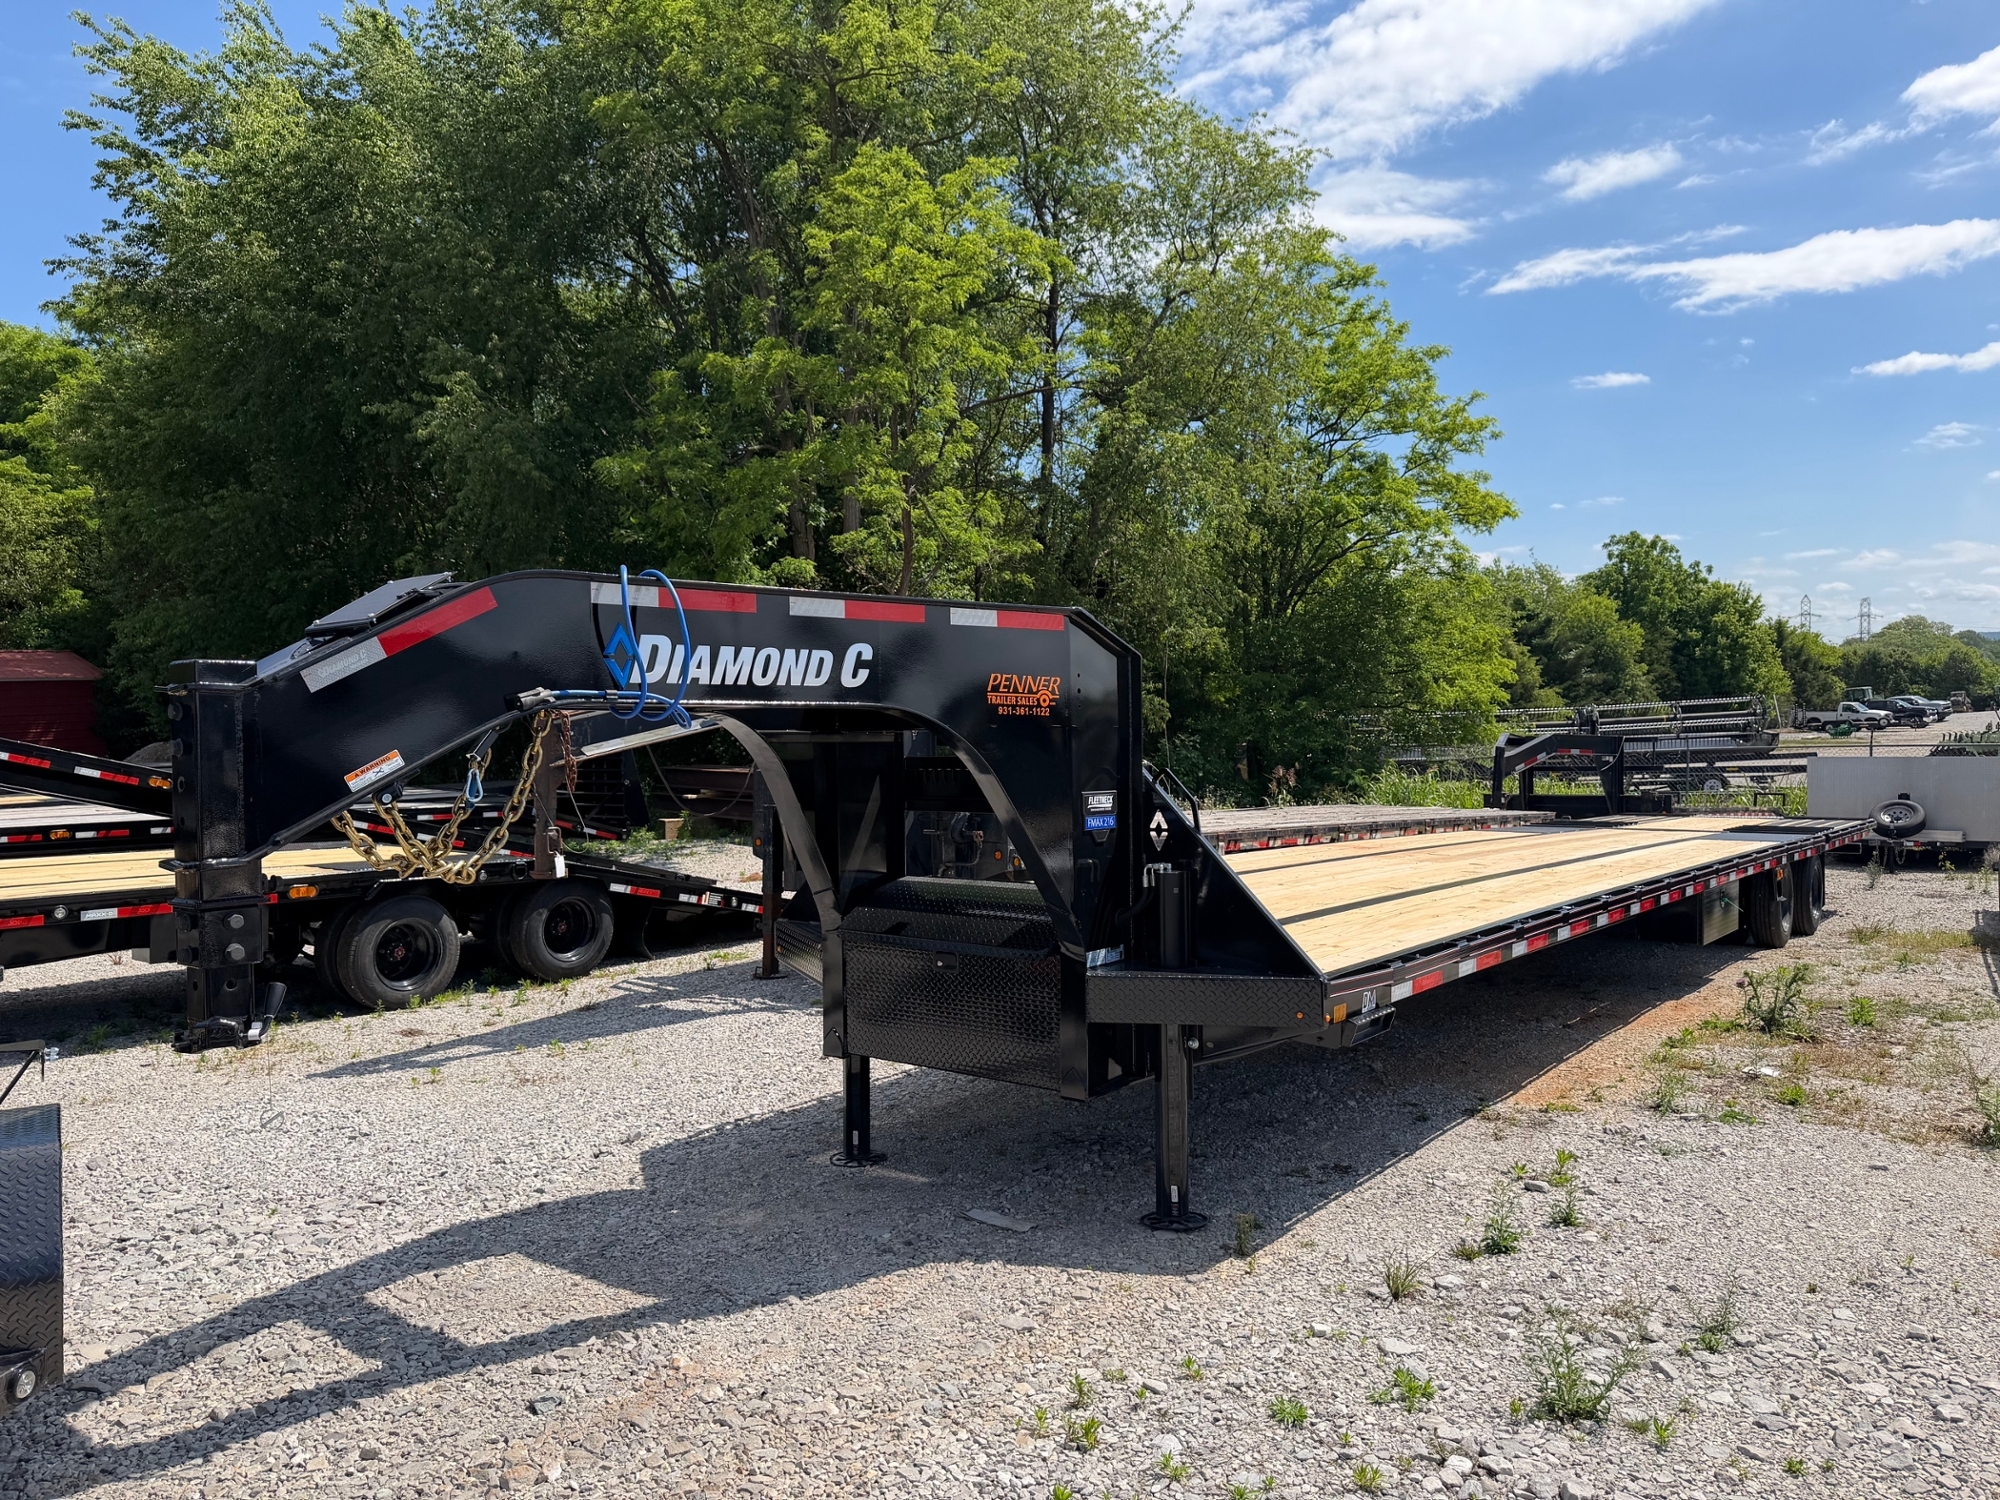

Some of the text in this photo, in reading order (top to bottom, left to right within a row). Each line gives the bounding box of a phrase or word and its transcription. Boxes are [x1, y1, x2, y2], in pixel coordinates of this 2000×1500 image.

[629, 634, 874, 688] DIAMOND C
[987, 673, 1061, 694] PENNER
[987, 696, 1038, 706] TRAILER SALES
[998, 706, 1050, 716] 931-361-1122
[360, 755, 391, 775] WARNING
[1088, 816, 1114, 828] FMAX 216
